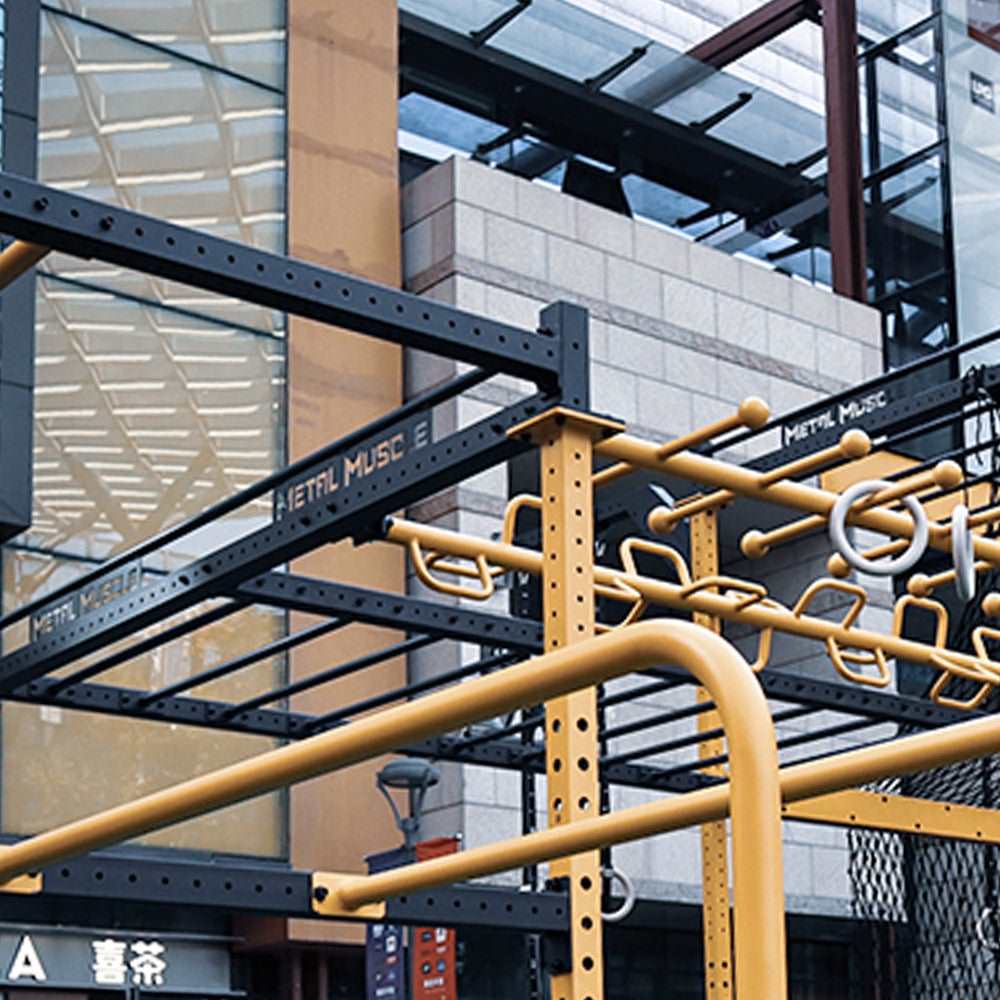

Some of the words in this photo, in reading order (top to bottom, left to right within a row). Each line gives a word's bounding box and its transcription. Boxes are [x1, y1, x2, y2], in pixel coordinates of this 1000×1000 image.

[783, 410, 835, 447] METAL
[838, 390, 887, 425] MUSC
[276, 466, 339, 521] METAL
[343, 420, 429, 487] MUSCE
[91, 938, 167, 985] 喜茶
